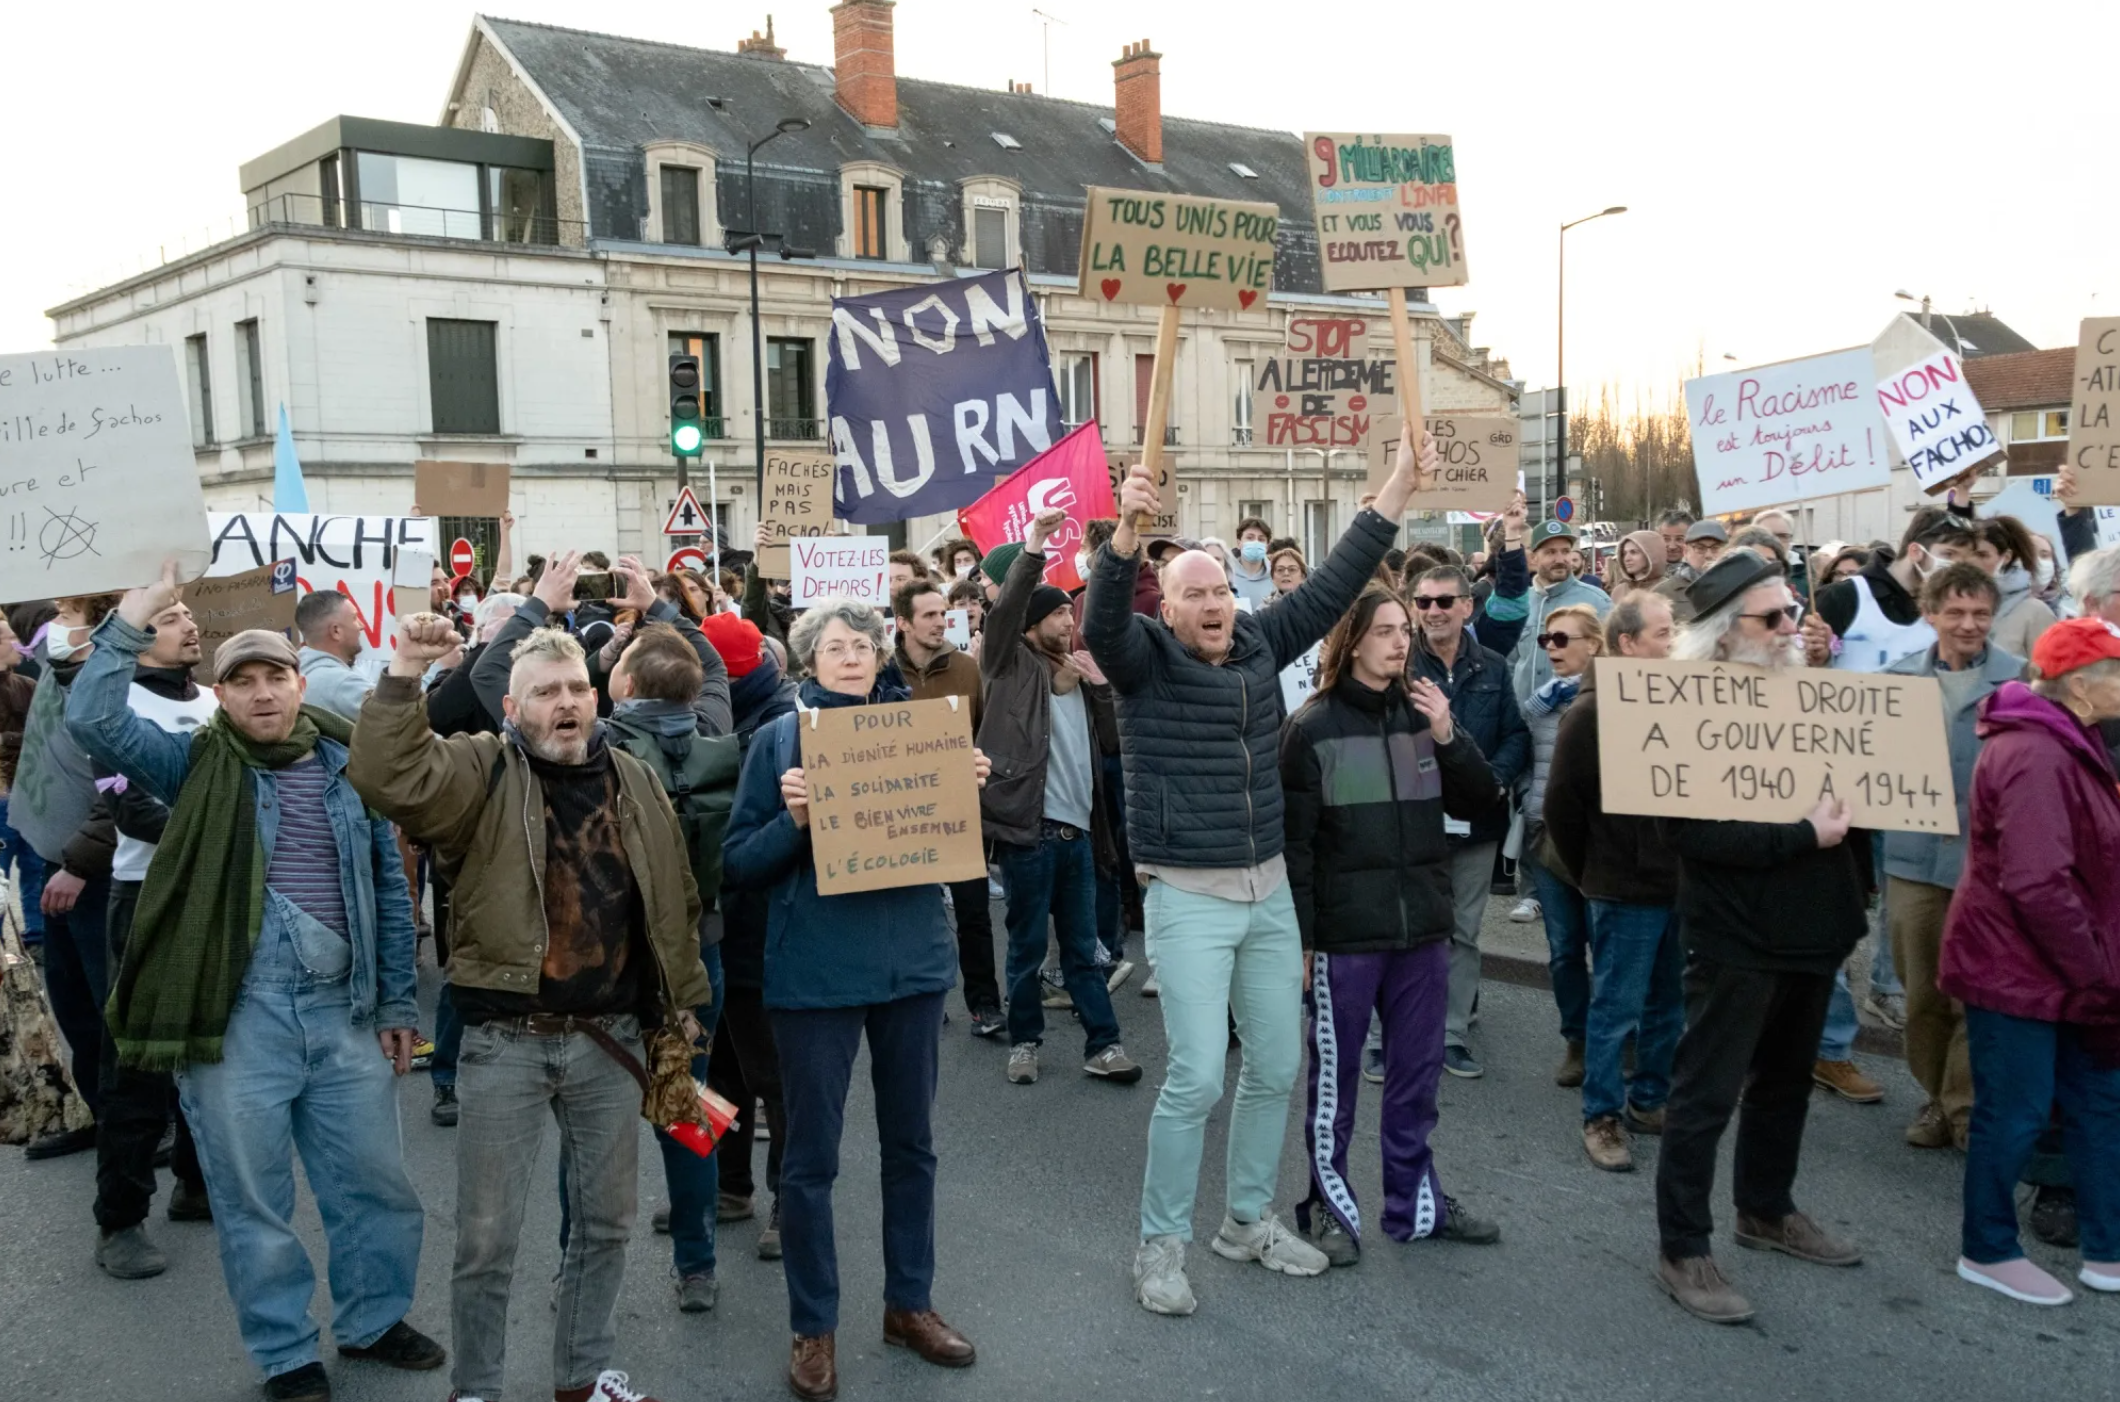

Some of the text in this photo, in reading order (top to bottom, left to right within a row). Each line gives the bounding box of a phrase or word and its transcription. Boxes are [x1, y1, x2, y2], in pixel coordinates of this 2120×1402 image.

[1314, 136, 1337, 187] 9
[1108, 198, 1165, 229] TOUS
[1233, 211, 1276, 244] POUR
[1322, 212, 1434, 233] ET VOUS VOUS
[1092, 242, 1125, 272] LA
[1143, 244, 1221, 280] BELLE
[1327, 240, 1405, 262] ECOUTEZ
[832, 271, 1029, 370] NON
[1287, 318, 1366, 358] STOP
[1737, 378, 1859, 421] Racisme
[1877, 355, 1958, 417] NON
[1301, 394, 1335, 416] DE
[2080, 403, 2110, 428] LA
[57, 411, 76, 435] de
[1426, 420, 1457, 437] LES
[1908, 398, 1962, 442] AUX
[831, 387, 1051, 504] AU RN
[1489, 433, 1513, 444] GRD
[1717, 420, 1833, 453] est toujours
[1909, 420, 1997, 480] FACHOS
[1382, 438, 1480, 466] FHOS
[58, 458, 97, 488] et
[767, 458, 831, 479] FACHÉS
[1716, 476, 1749, 491] un
[1758, 443, 1856, 483] Délit
[769, 500, 812, 515] PAS
[797, 543, 885, 569] VOTEZ-LES
[1618, 665, 1770, 709] L'EXTÊME
[853, 710, 913, 732] POUR
[1642, 719, 1876, 757] A GOUVERNÉ
[808, 753, 831, 770] LA
[813, 783, 835, 803] LA
[1651, 762, 1943, 809] DE 1940 À 1944
[819, 815, 840, 831] LE
[887, 820, 968, 840] ENSEMBLE
